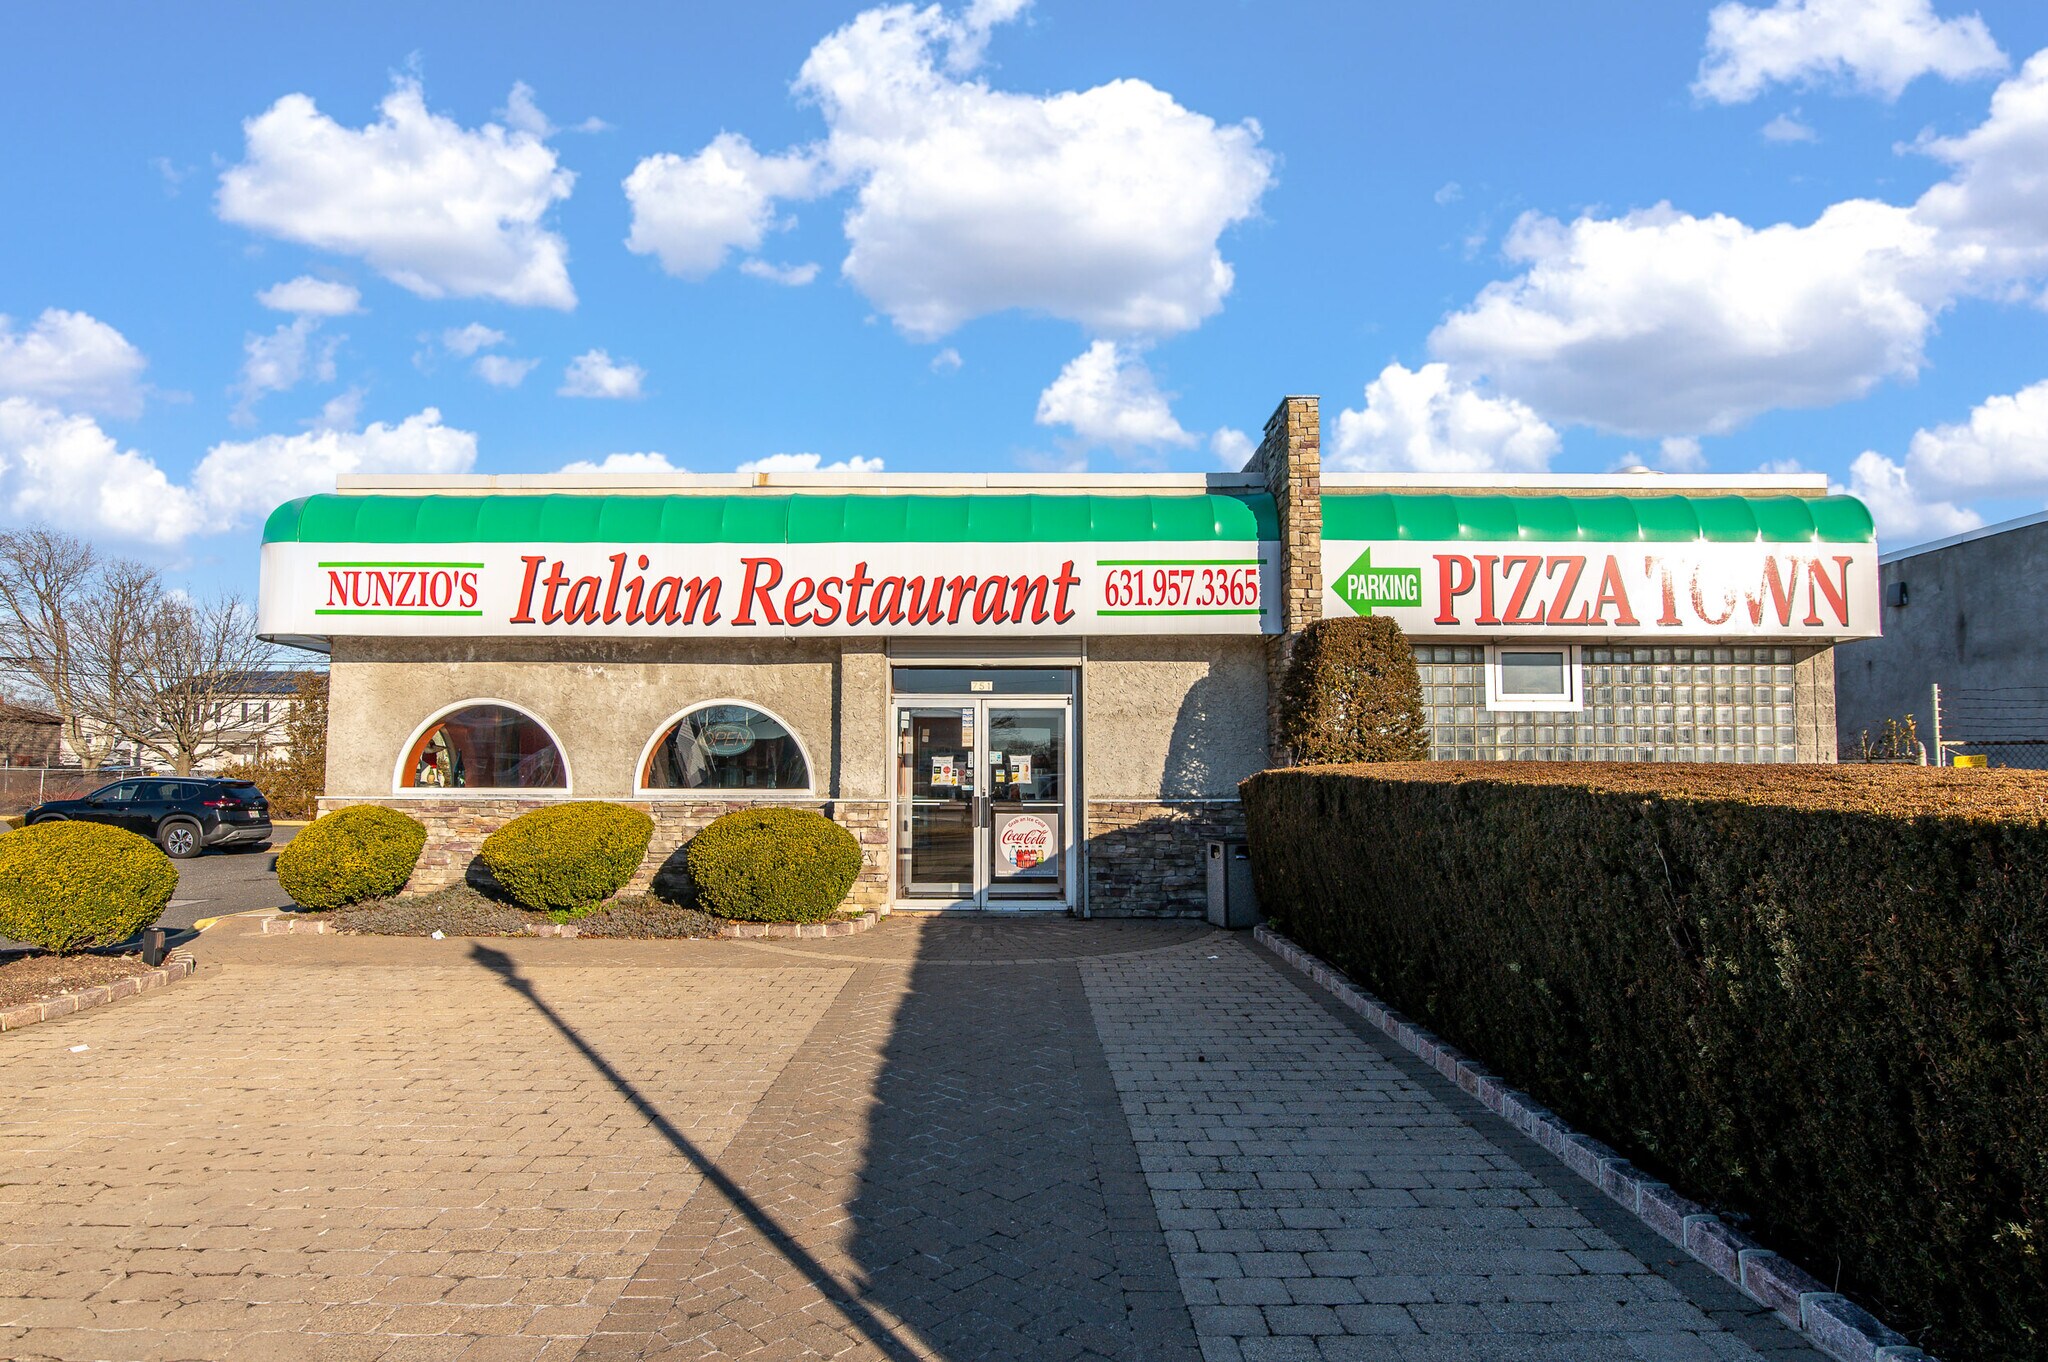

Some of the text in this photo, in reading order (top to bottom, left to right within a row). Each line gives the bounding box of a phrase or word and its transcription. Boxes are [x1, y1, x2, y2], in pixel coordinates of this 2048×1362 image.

[326, 570, 478, 608] NUNZIO'S
[509, 551, 1081, 626] Italian Restaurant
[1104, 567, 1258, 609] 631.957.3365
[1347, 574, 1417, 600] PARKING
[1433, 554, 1853, 628] PIZZA TOWN
[972, 682, 991, 690] 751
[704, 731, 751, 747] OPEN
